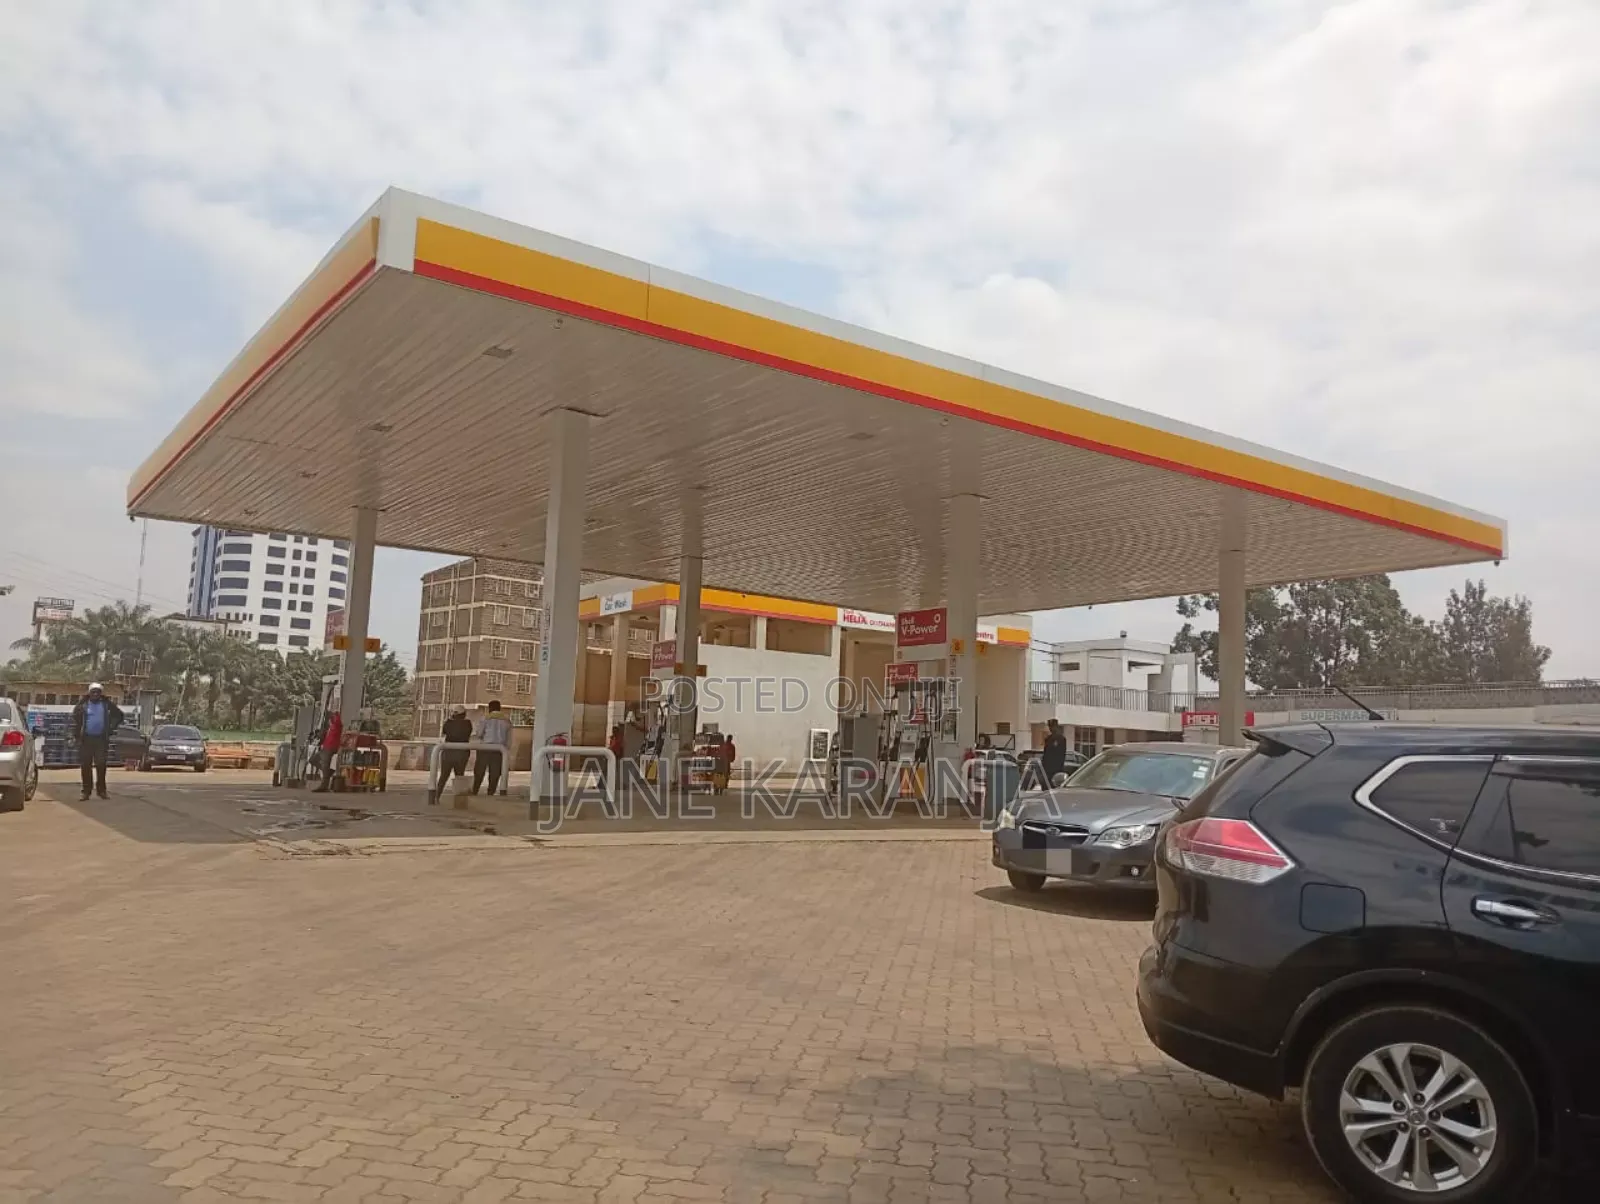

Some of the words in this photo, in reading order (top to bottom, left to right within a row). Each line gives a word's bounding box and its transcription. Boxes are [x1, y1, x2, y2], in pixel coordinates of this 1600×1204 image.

[843, 613, 868, 625] HELIX
[900, 616, 915, 626] Shell
[900, 624, 939, 637] V-Power
[1187, 714, 1217, 725] HIGH
[1300, 710, 1393, 721] SUPERMARET
